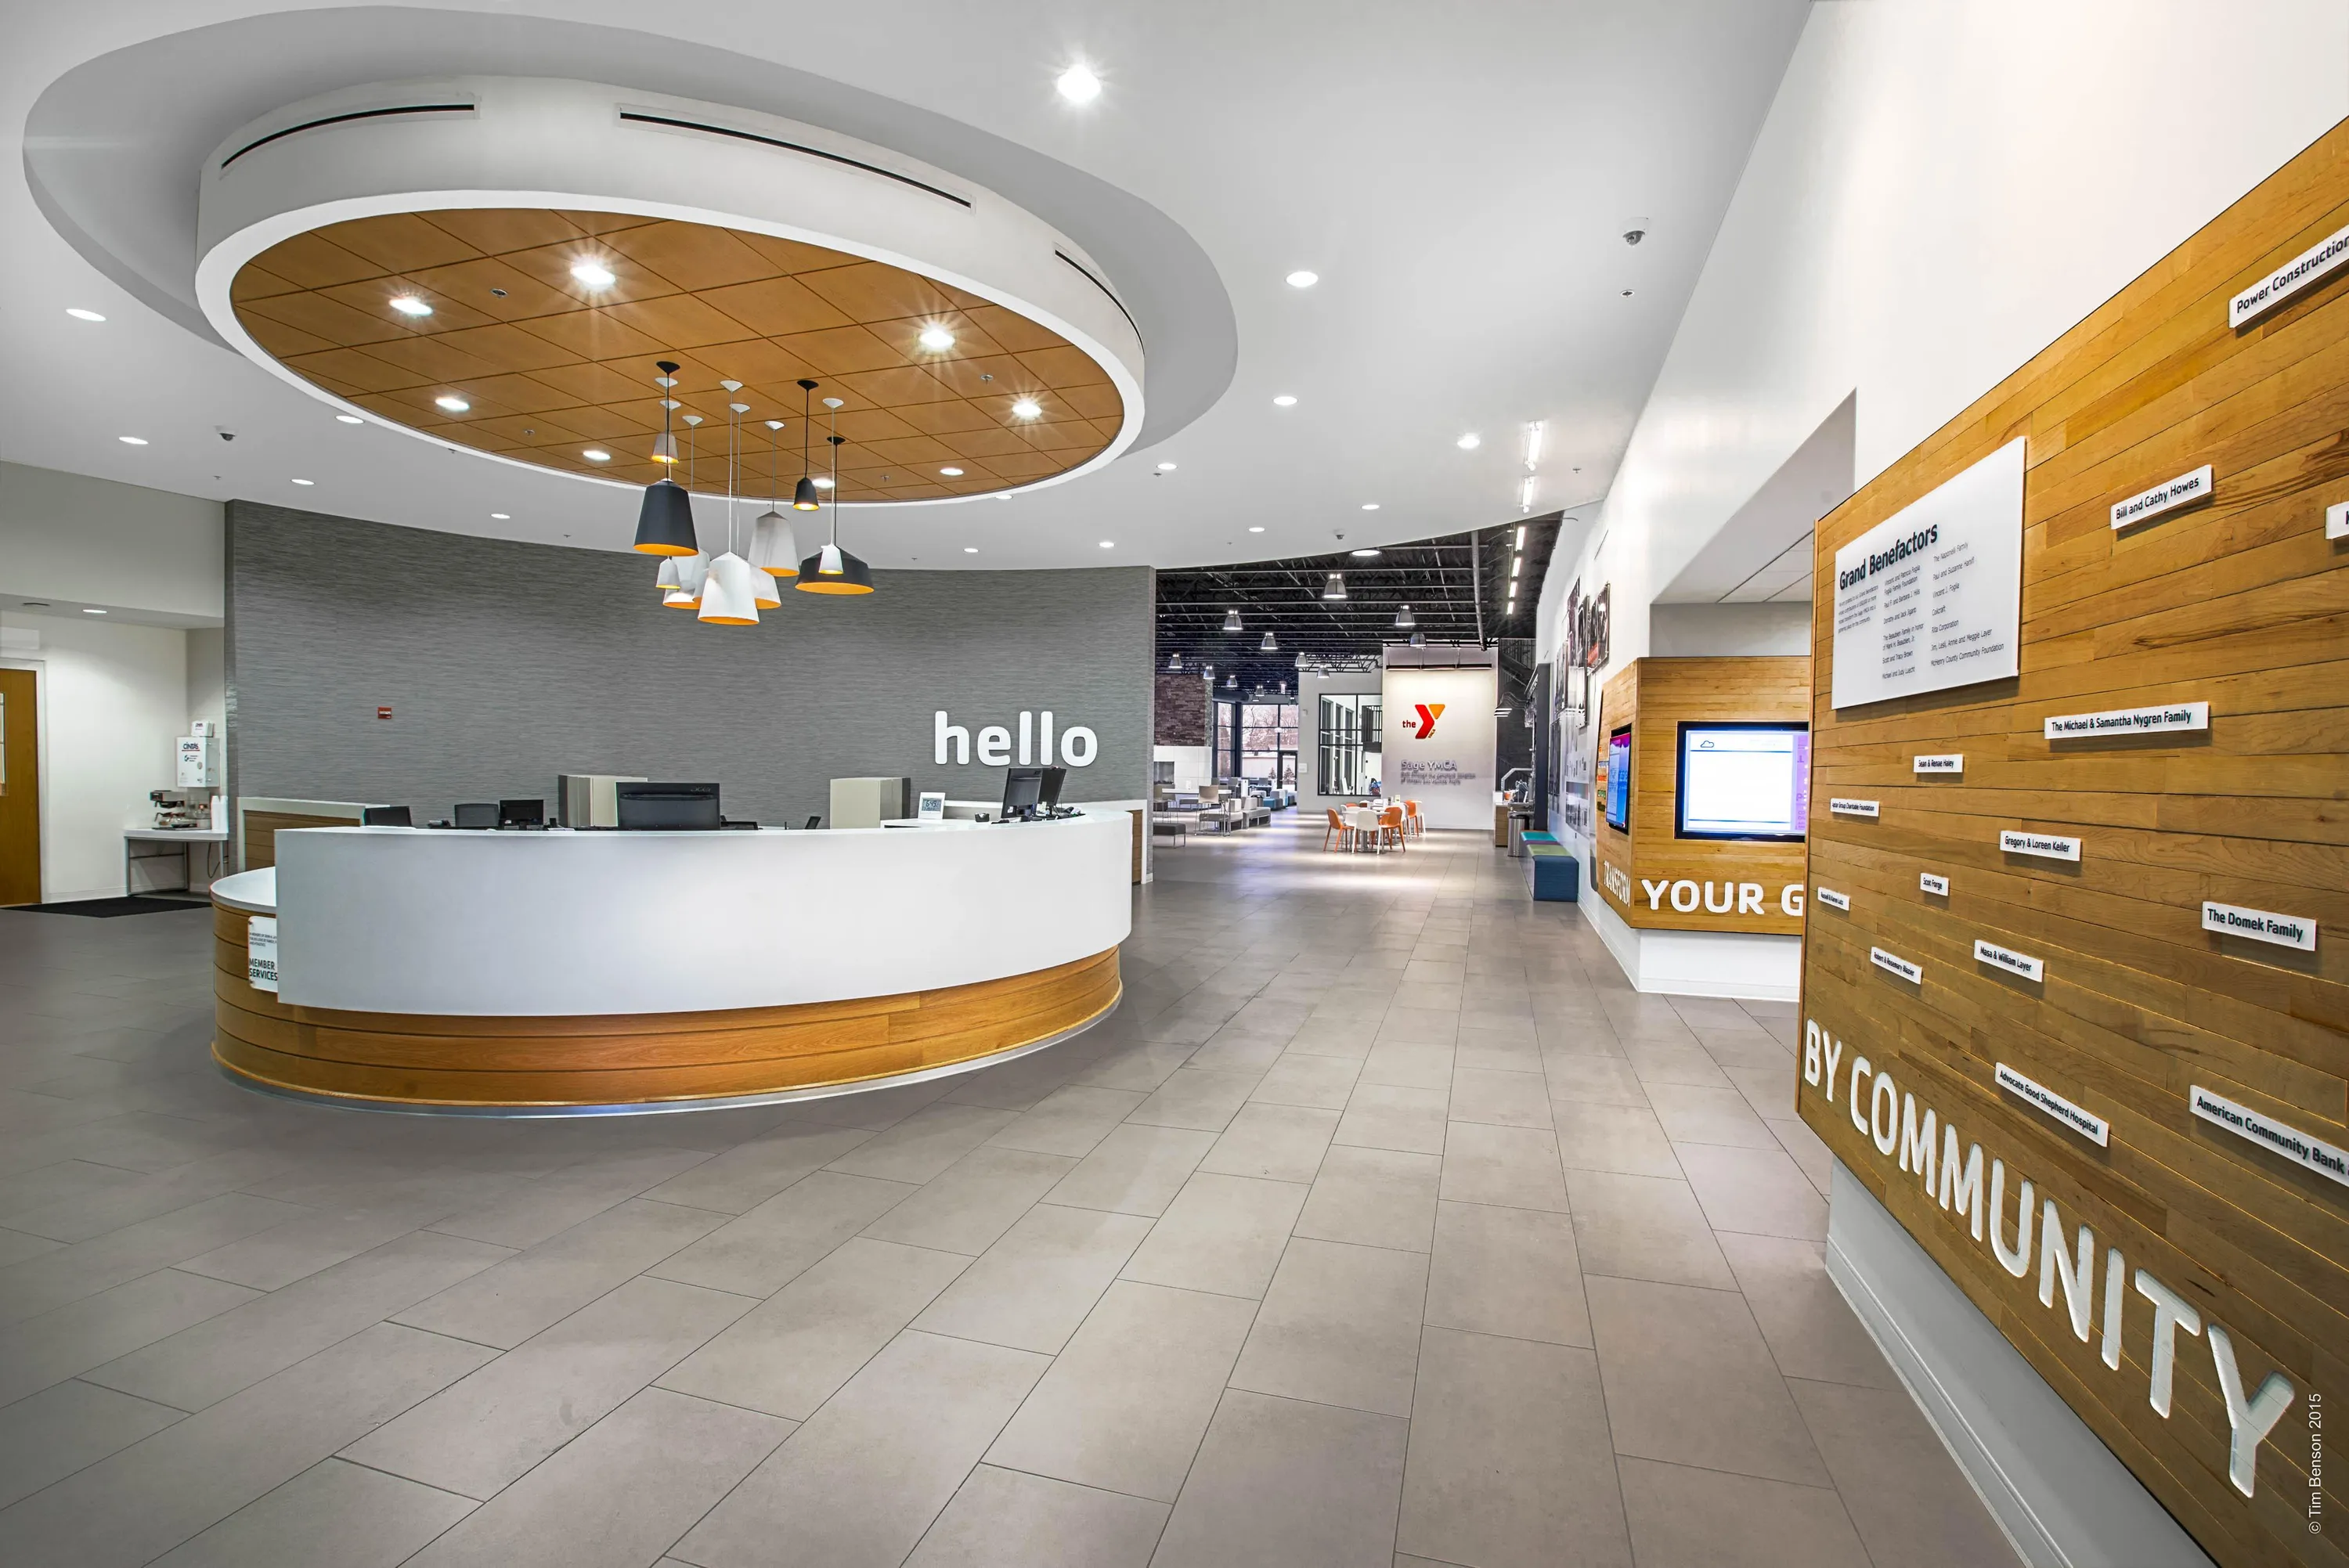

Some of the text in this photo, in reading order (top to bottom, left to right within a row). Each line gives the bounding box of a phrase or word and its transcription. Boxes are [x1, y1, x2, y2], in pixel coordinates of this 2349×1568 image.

[2237, 286, 2269, 313] Power
[2116, 478, 2199, 519] Bill and Cathy Howes
[1957, 542, 1968, 551] Family
[1839, 524, 1938, 590] Grand Benefactors
[1948, 564, 1963, 575] Suzanne
[1902, 576, 1918, 586] Foundation
[1932, 589, 1945, 598] Vincent
[1939, 620, 1959, 631] Corporation
[1981, 629, 1993, 637] Layer
[1946, 654, 1958, 663] County
[1959, 649, 1980, 660] Community
[1981, 643, 2004, 654] Foundation
[1402, 719, 1416, 728] the
[2051, 709, 2192, 731] The Michael & Samantha Nygren Family
[935, 711, 1098, 767] hello
[1401, 759, 1457, 771] Sage YMCA
[2004, 836, 2070, 852] Gregory & Loreen Keller
[1604, 860, 1631, 908] TRANSFORM
[1932, 879, 1943, 891] Forge
[1641, 879, 1765, 915] YOUR
[2208, 908, 2304, 943] The Domek Family
[249, 957, 275, 970] MEMBER
[1980, 946, 2032, 971] Masa & William Layer
[249, 968, 278, 981] SERVICES
[2000, 1070, 2098, 1135] Advocate Good Shepherd Hospital
[2197, 1096, 2243, 1127] American
[2246, 1117, 2309, 1160] Community
[2312, 1146, 2345, 1174] Bank
[1805, 1018, 2295, 1498] BY COMMUNITY
